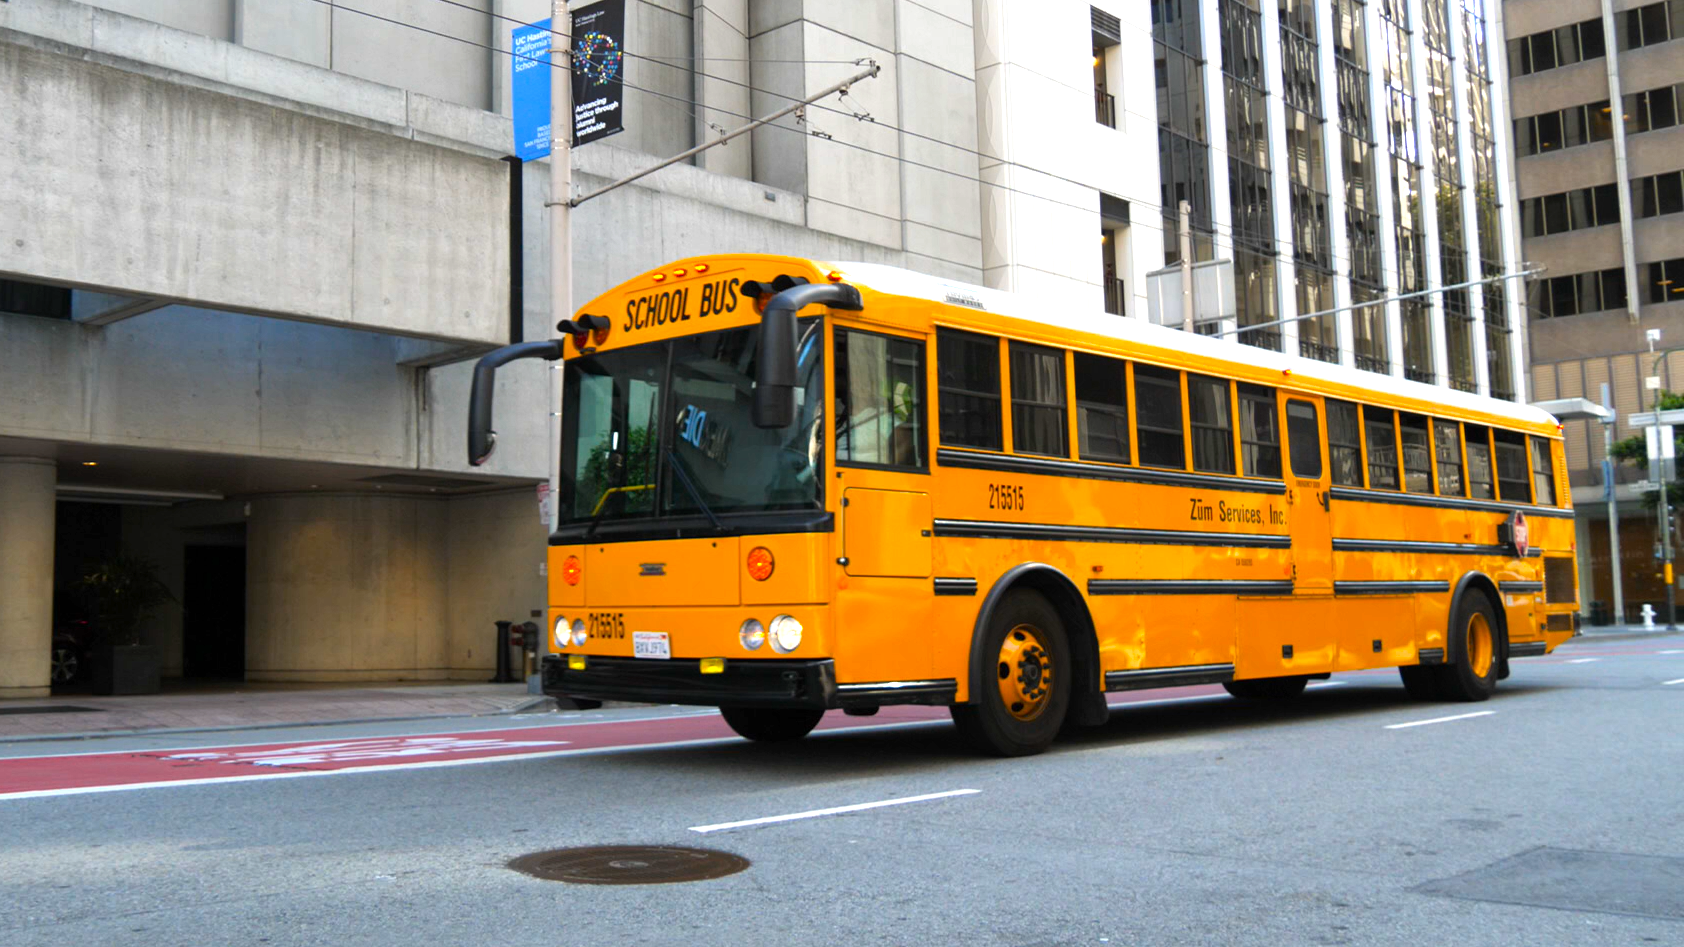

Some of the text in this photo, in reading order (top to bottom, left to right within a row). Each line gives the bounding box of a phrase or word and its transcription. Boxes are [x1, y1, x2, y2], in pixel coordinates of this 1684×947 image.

[515, 36, 526, 46] UC
[531, 49, 546, 59] Law
[515, 59, 539, 72] School
[575, 97, 608, 113] Advancing
[594, 101, 620, 115] through
[575, 116, 596, 130] alumni
[576, 122, 607, 138] worldwide
[624, 278, 739, 332] SCHOOL BUS
[988, 483, 1025, 512] 215515
[1219, 500, 1265, 528] Services,
[1269, 504, 1288, 525] Inc.
[588, 613, 625, 639] 215515
